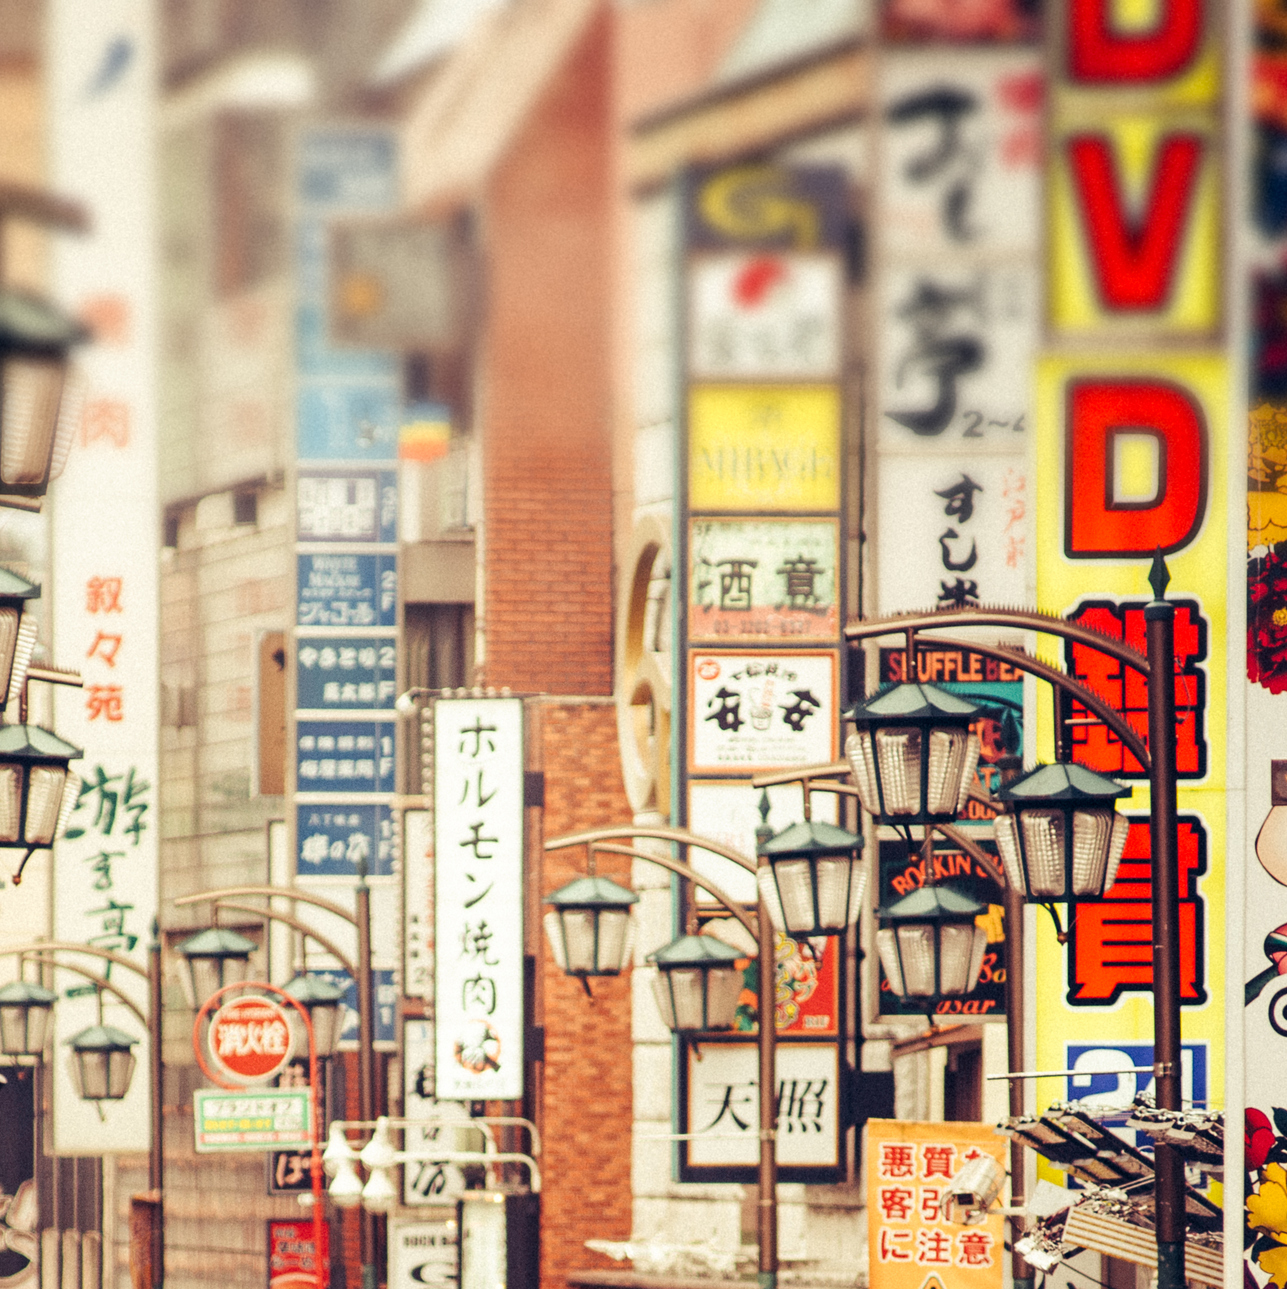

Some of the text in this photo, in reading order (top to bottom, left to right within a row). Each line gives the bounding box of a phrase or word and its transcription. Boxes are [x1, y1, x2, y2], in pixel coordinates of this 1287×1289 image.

[85, 575, 126, 724] 叙々苑
[458, 716, 500, 1016] ホルモン焼肉
[217, 1019, 287, 1057] 消火栓
[696, 1078, 828, 1134] 天照
[881, 1229, 990, 1265] に注意
